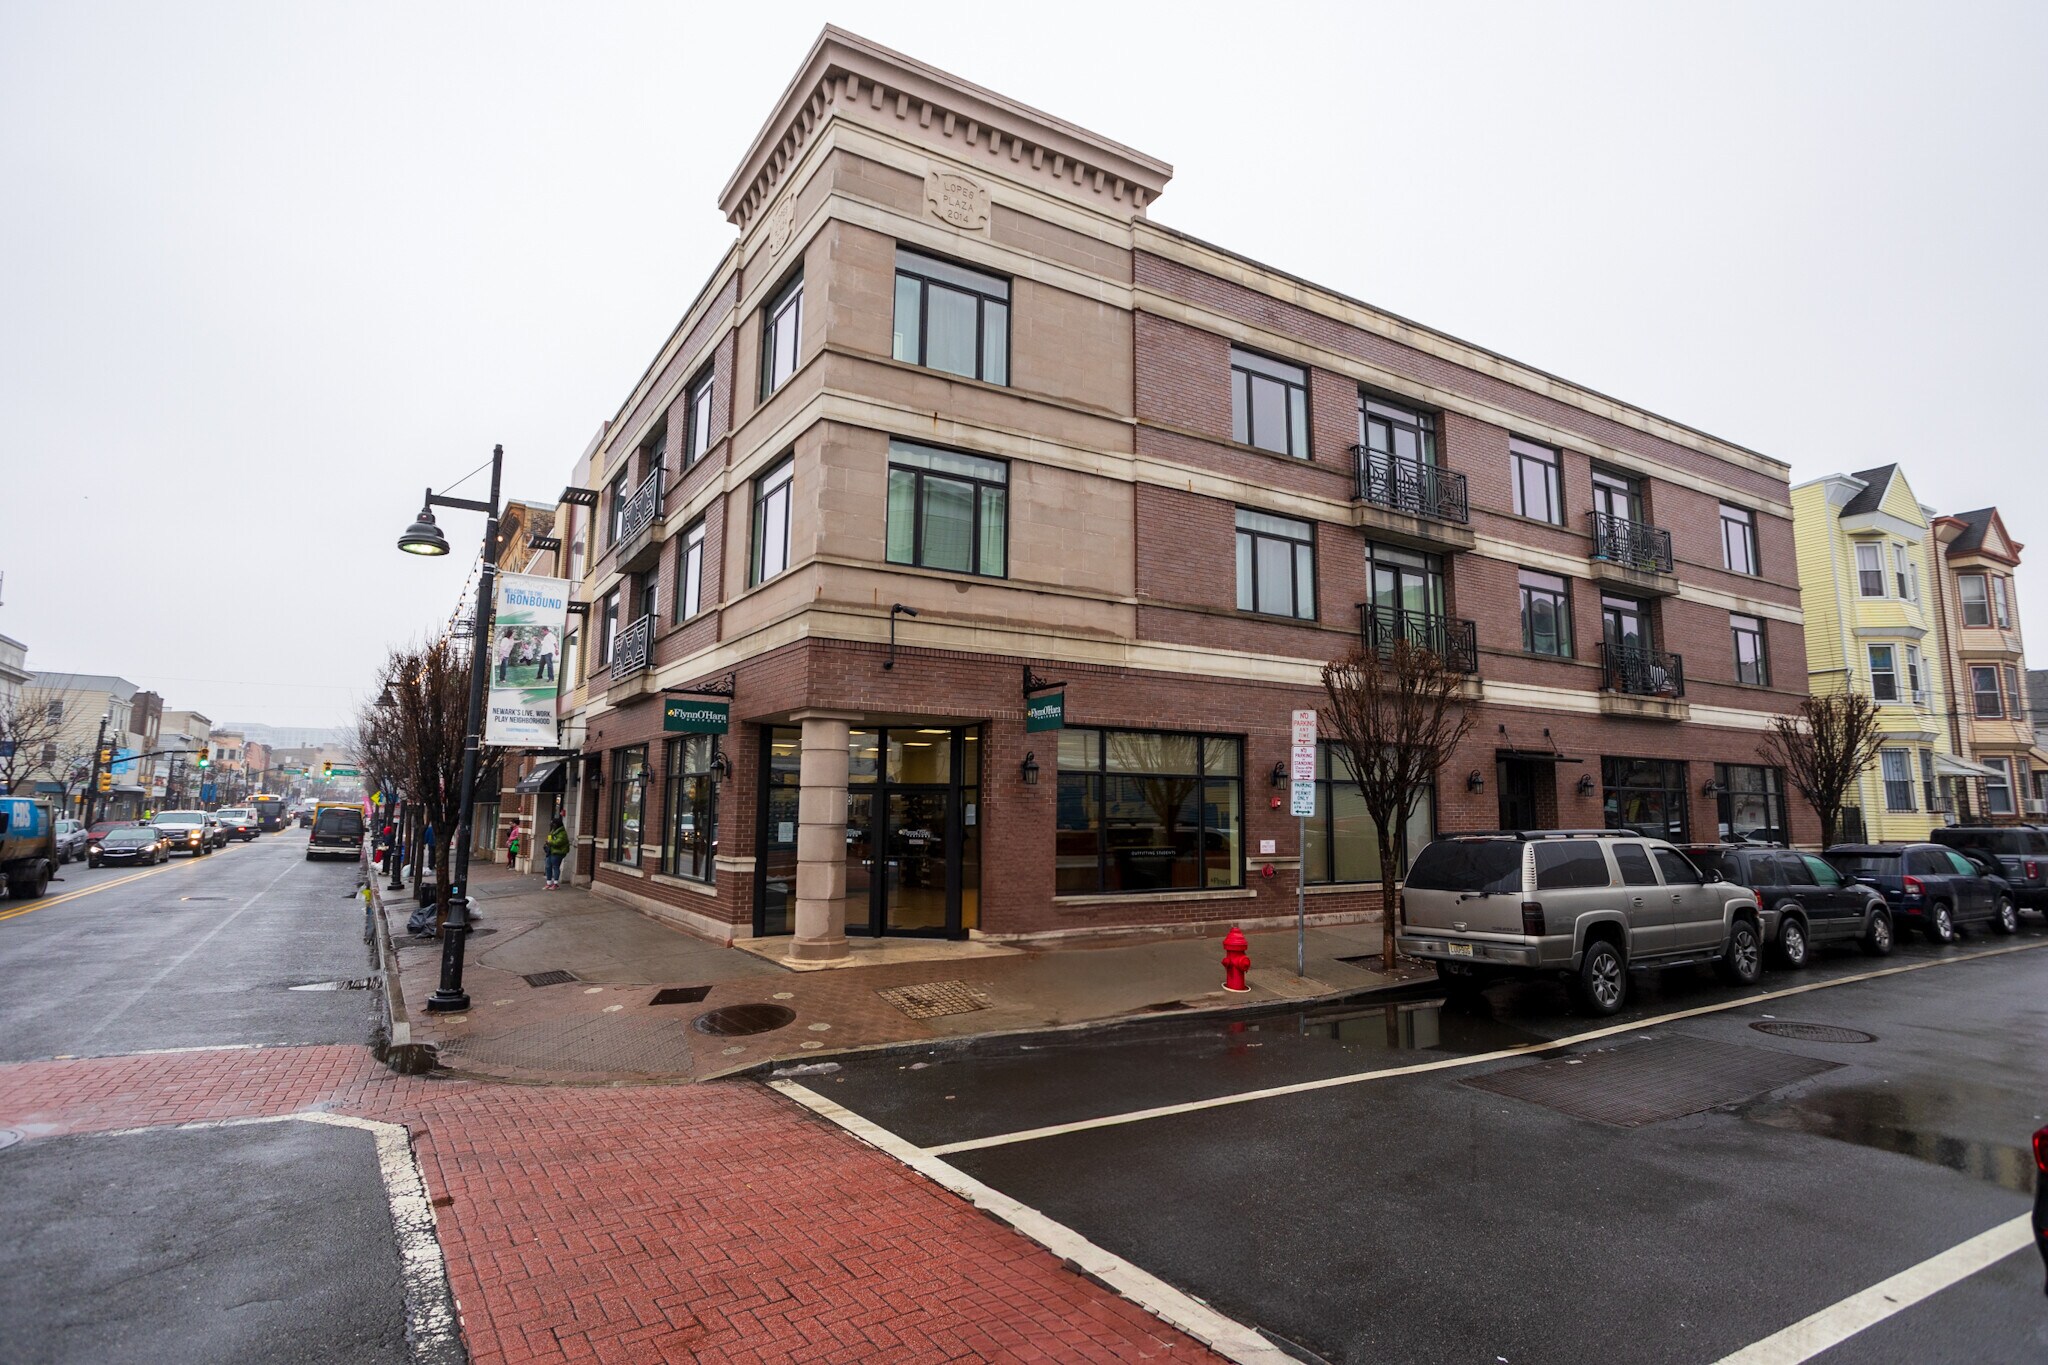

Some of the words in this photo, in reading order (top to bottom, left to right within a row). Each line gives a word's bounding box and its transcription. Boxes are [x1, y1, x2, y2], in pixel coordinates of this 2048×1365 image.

[944, 182, 974, 199] LOPES
[943, 195, 974, 212] PLAZA
[947, 209, 969, 223] 2014
[506, 593, 562, 609] IRONBOUND
[492, 707, 521, 716] NEWARK'S
[673, 708, 726, 721] FlynnO'Hara
[1030, 705, 1061, 718] FlynnO'Hara
[509, 717, 550, 725] NEIGHBORHOOD
[1293, 719, 1315, 727] PARKING
